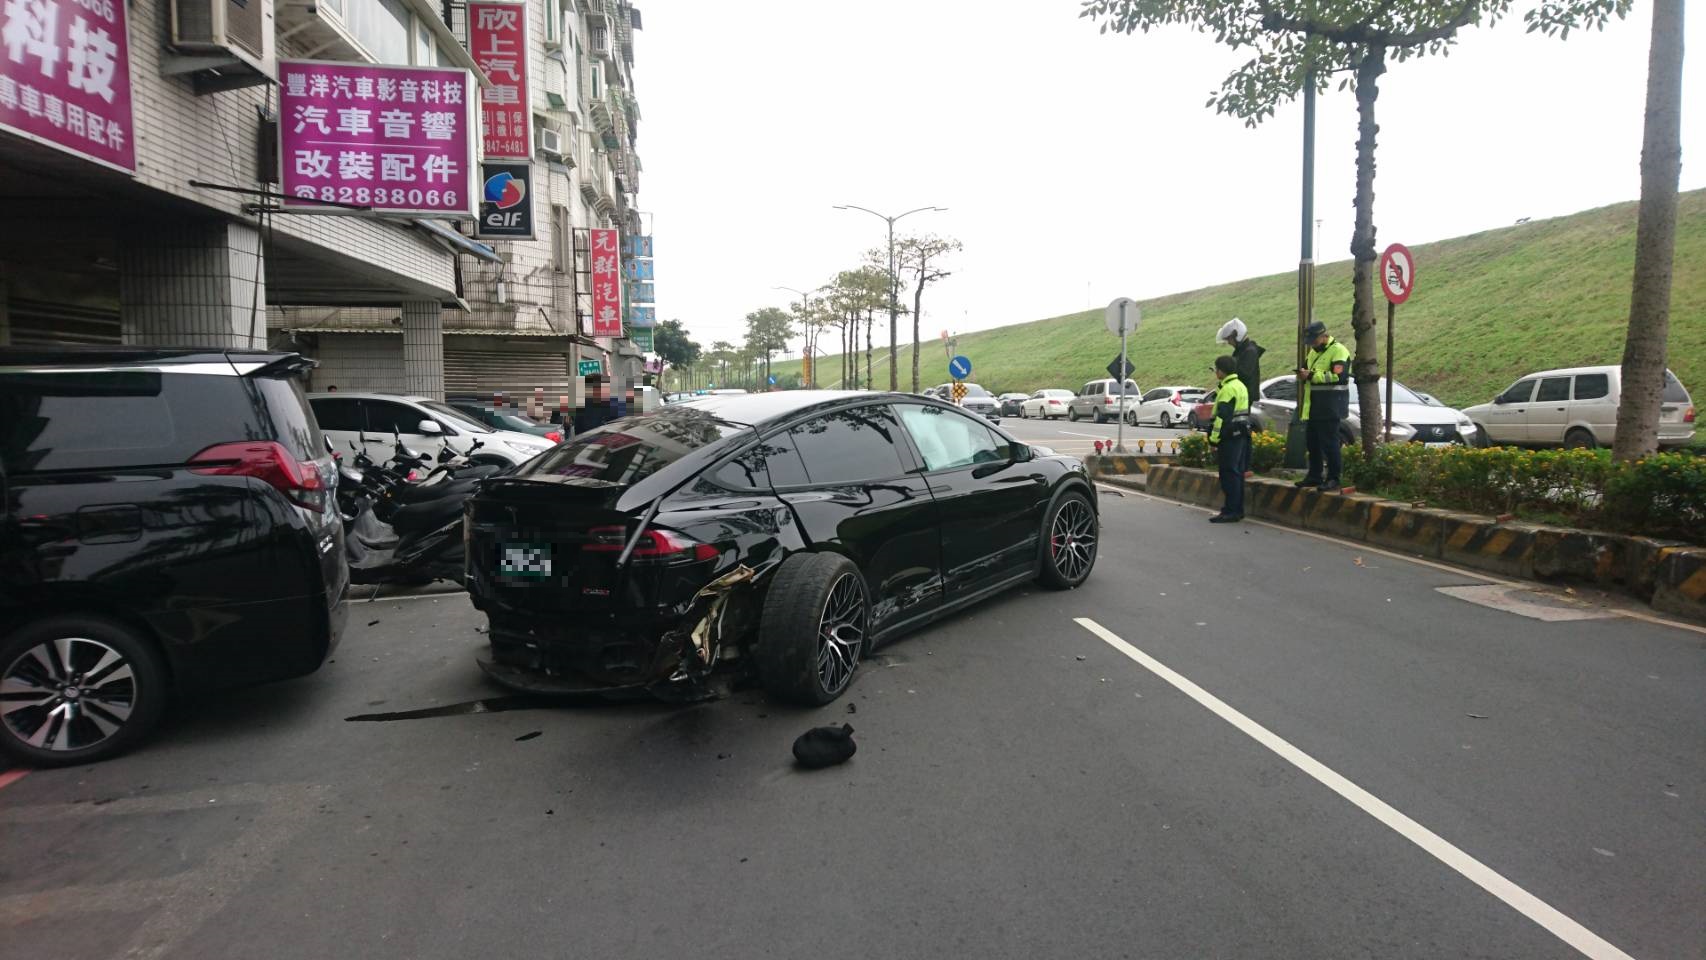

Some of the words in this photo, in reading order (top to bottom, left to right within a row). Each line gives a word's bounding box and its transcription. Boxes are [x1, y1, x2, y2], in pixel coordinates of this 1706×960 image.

[1, 0, 118, 103] 科技
[477, 8, 520, 105] 欣上汽車
[286, 73, 463, 104] 豐洋汽車影音科技
[0, 74, 125, 151] 專車專用配件
[293, 105, 457, 140] 汽車音響
[294, 150, 459, 183] 改裝配件
[321, 186, 457, 207] 82838066
[487, 212, 522, 227] elf
[594, 231, 618, 327] 元群汽車
